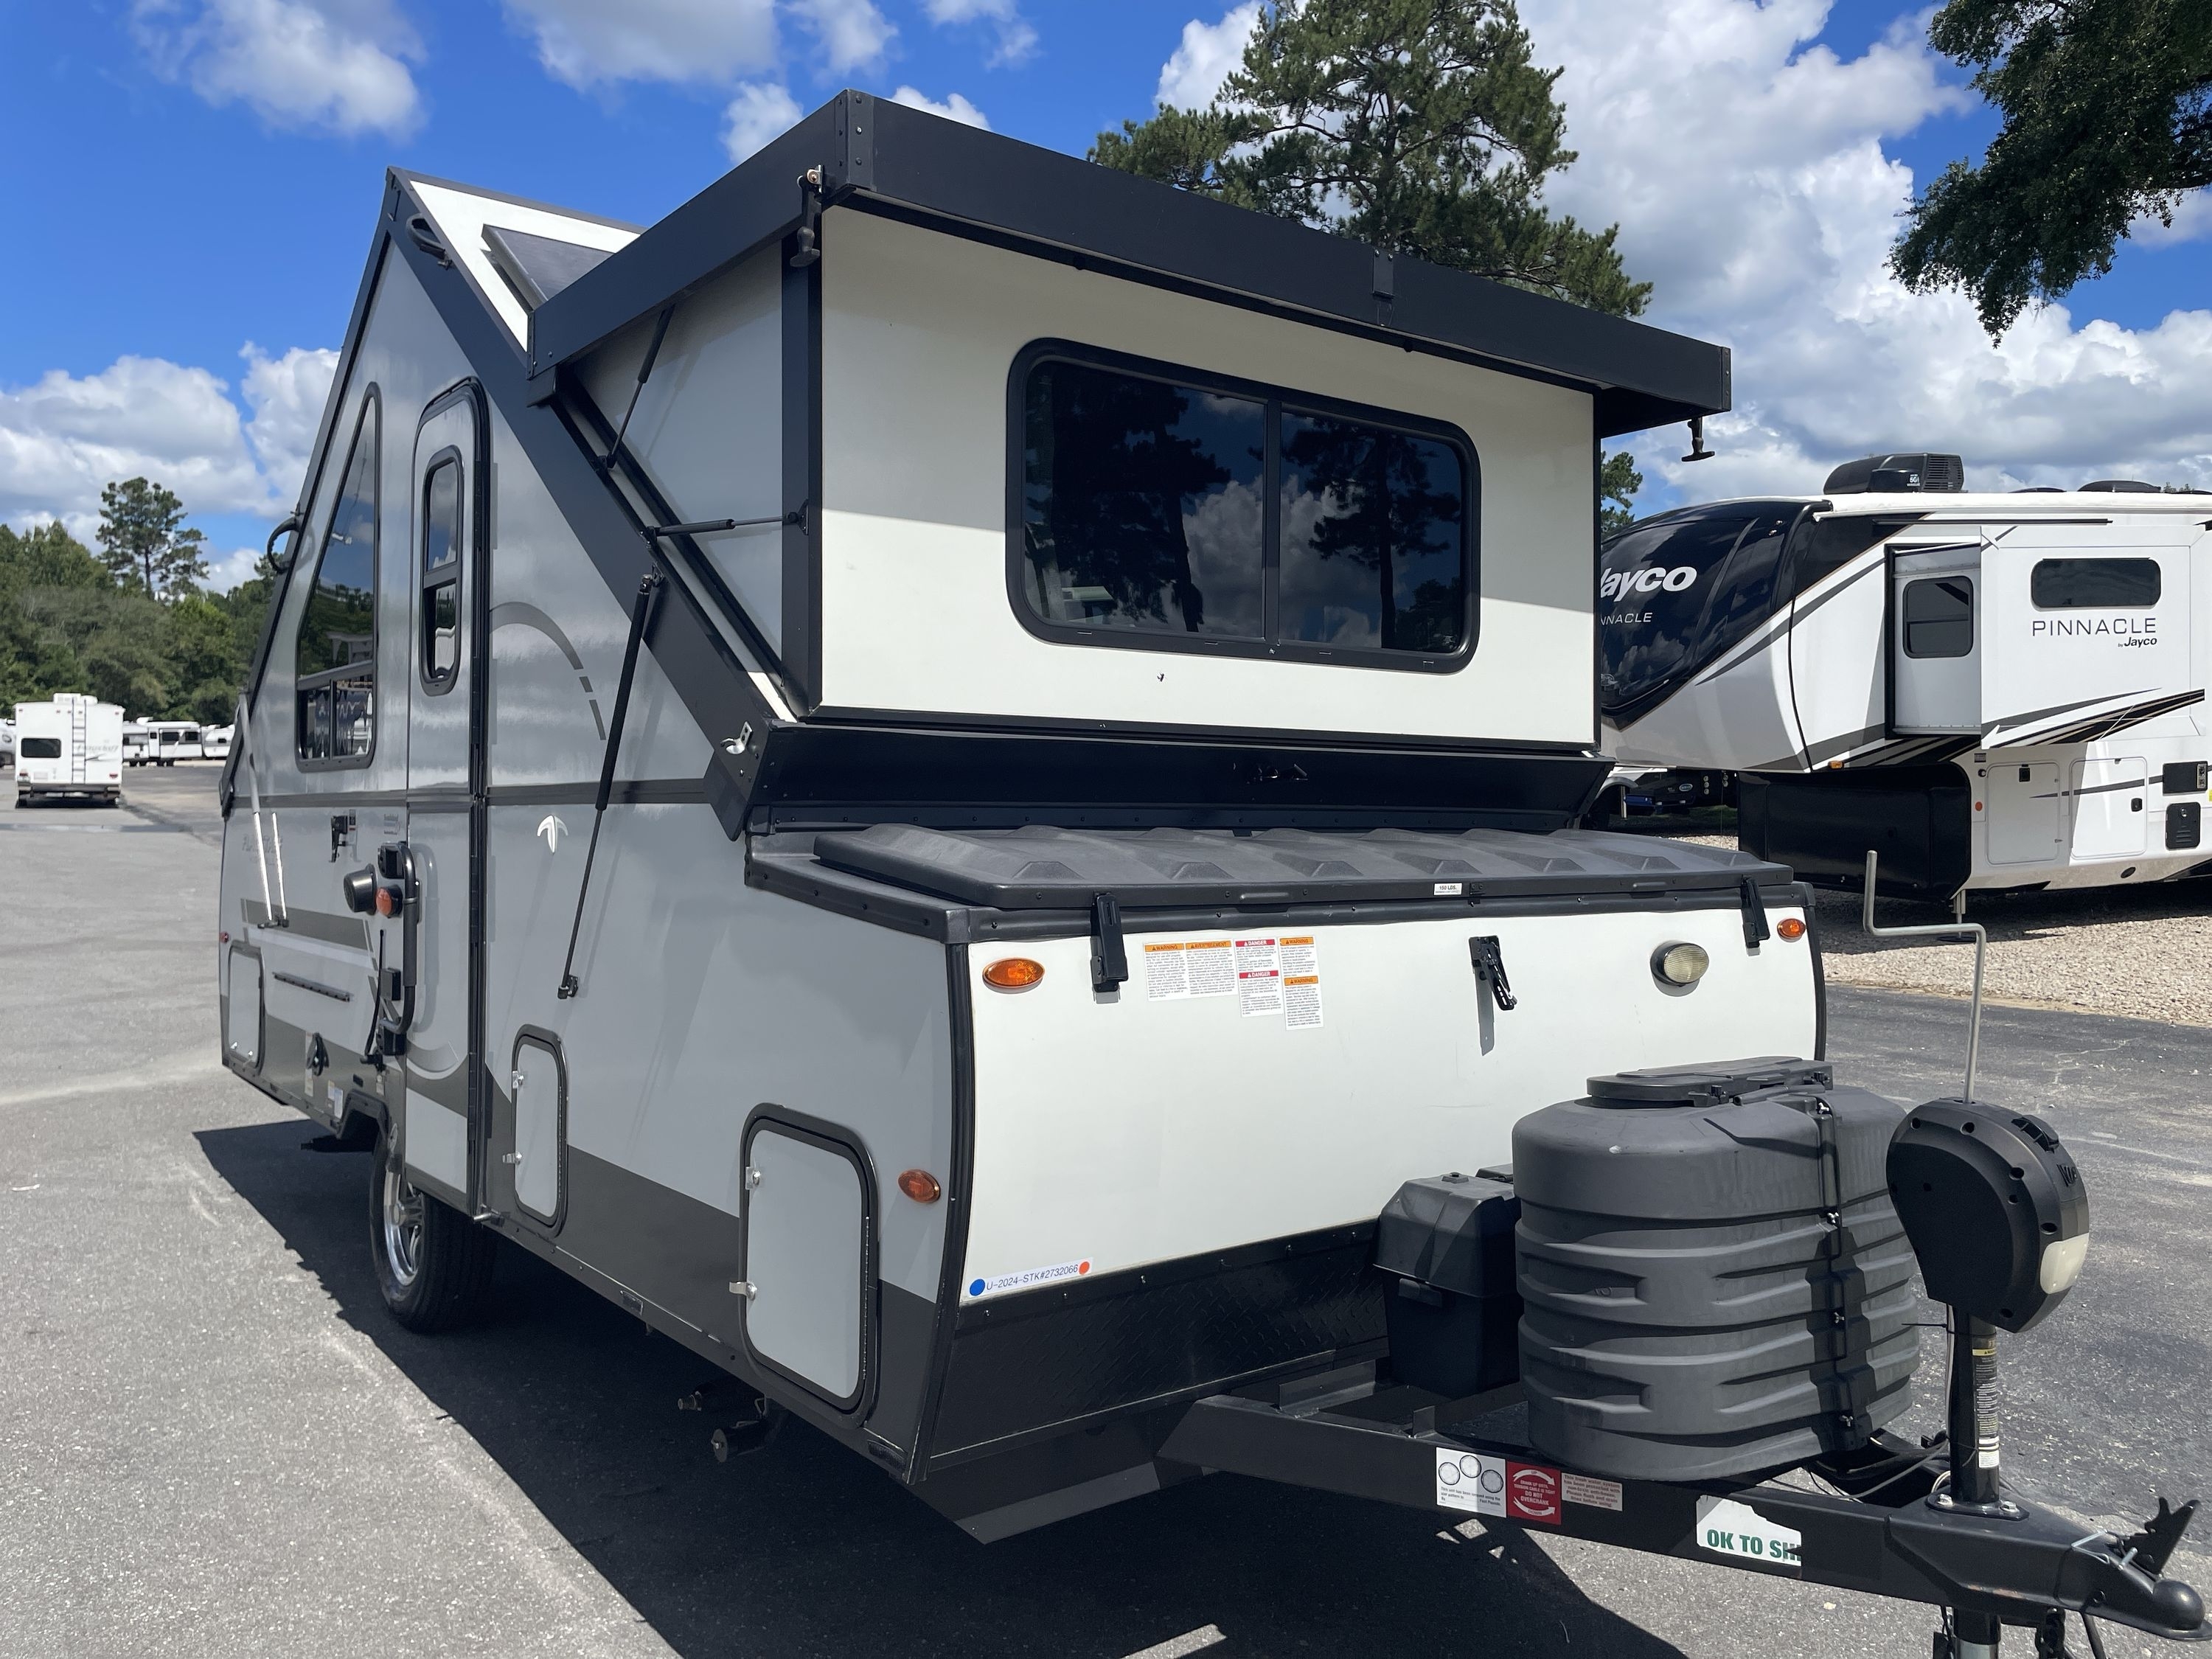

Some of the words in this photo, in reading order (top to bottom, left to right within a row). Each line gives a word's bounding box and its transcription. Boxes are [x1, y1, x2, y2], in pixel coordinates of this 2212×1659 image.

[2033, 618, 2156, 636] PINNACLE
[2124, 637, 2157, 647] Jayco
[987, 1264, 1078, 1290] U-2024-STK#2732066
[1520, 1495, 1549, 1506] OVERCRANK
[1707, 1528, 1734, 1550] OK
[1739, 1534, 1763, 1555] TO
